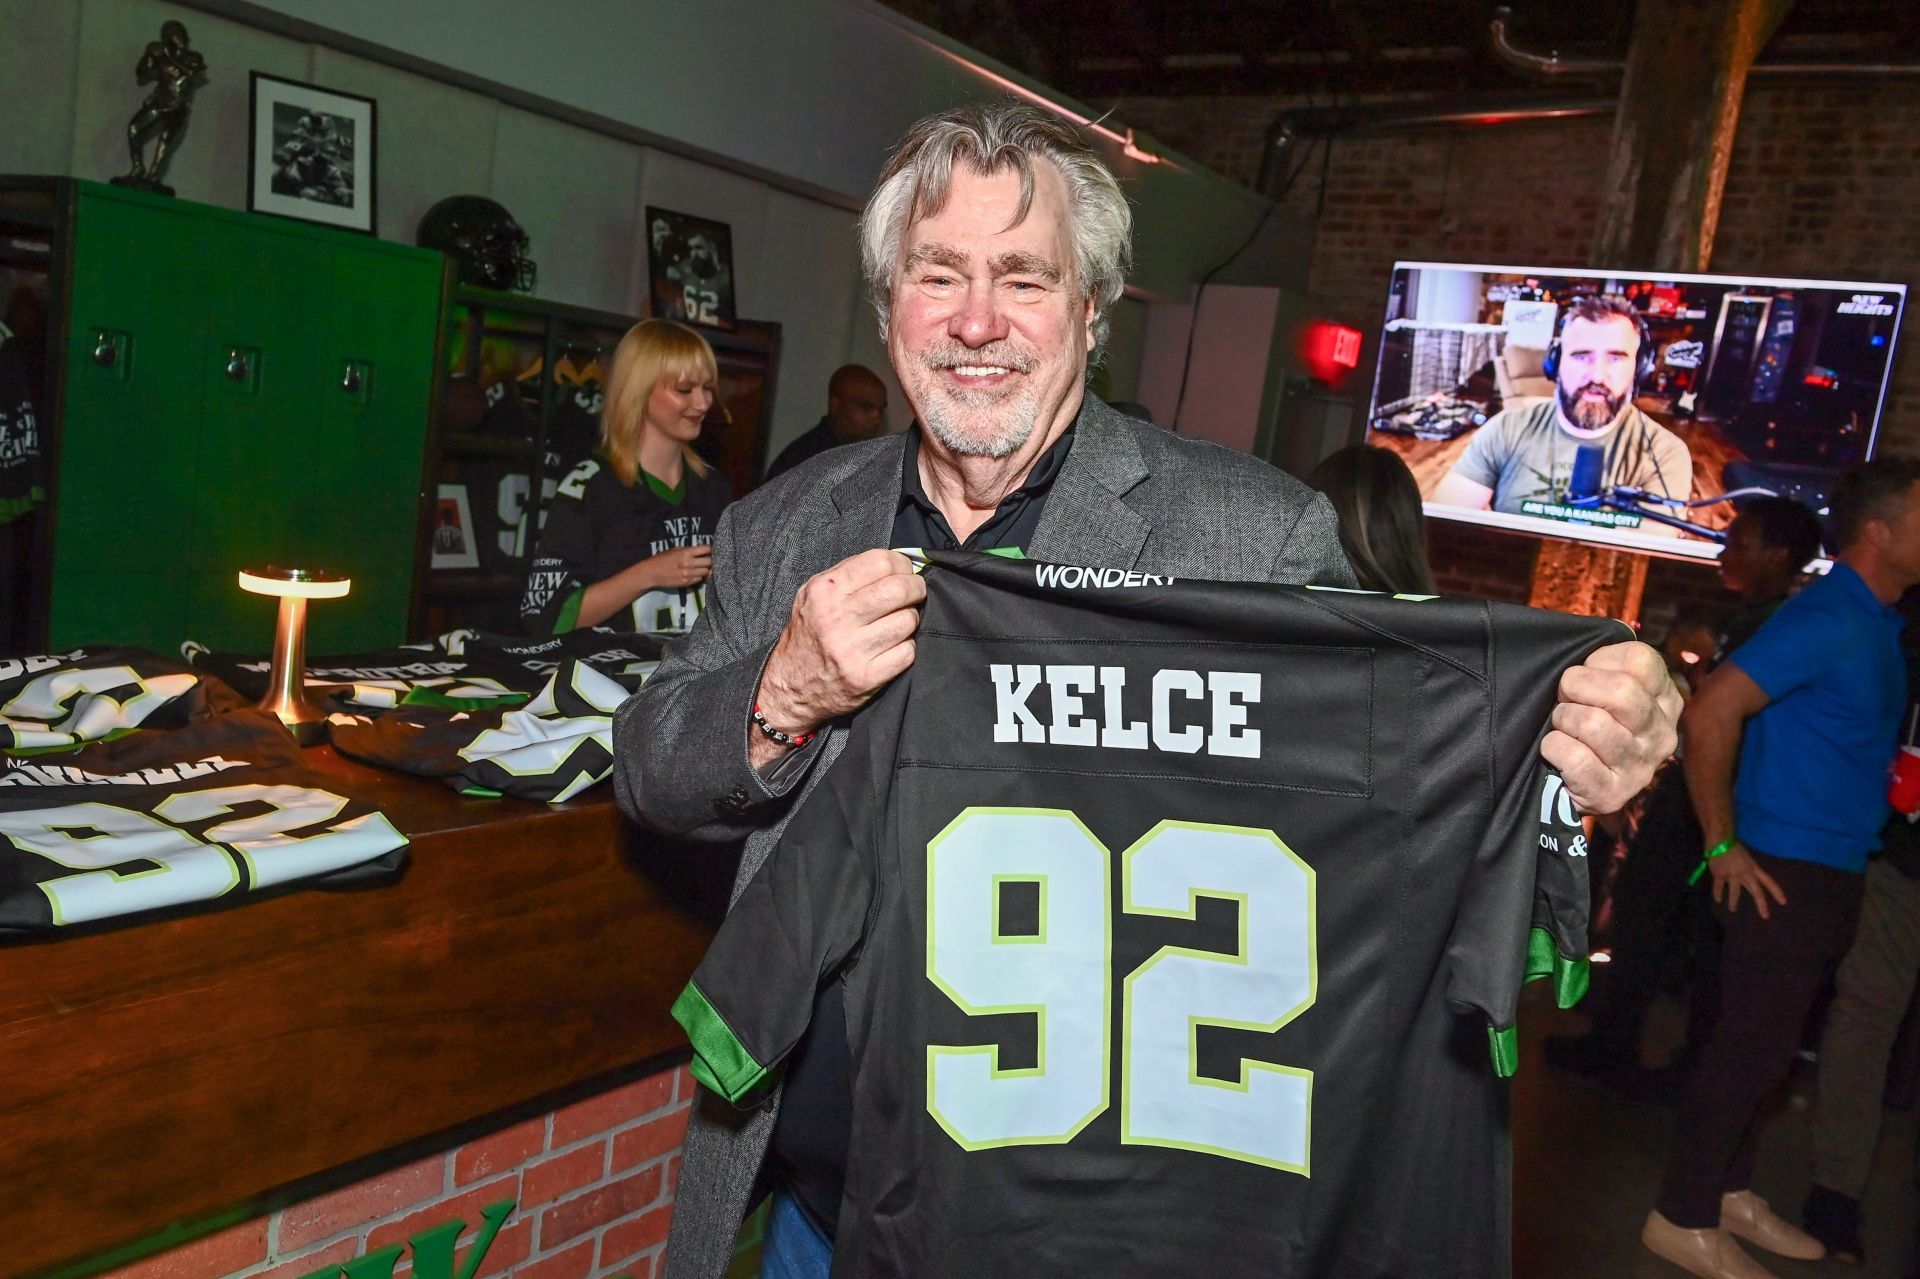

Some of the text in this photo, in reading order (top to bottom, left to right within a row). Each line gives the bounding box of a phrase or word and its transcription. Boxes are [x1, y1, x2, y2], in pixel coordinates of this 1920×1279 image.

[1523, 502, 1544, 515] ARE
[1544, 504, 1565, 517] YOU
[1573, 509, 1615, 524] KANSAS
[1614, 514, 1640, 528] CITY
[990, 664, 1262, 759] KELCE
[926, 806, 1318, 1179] 92
